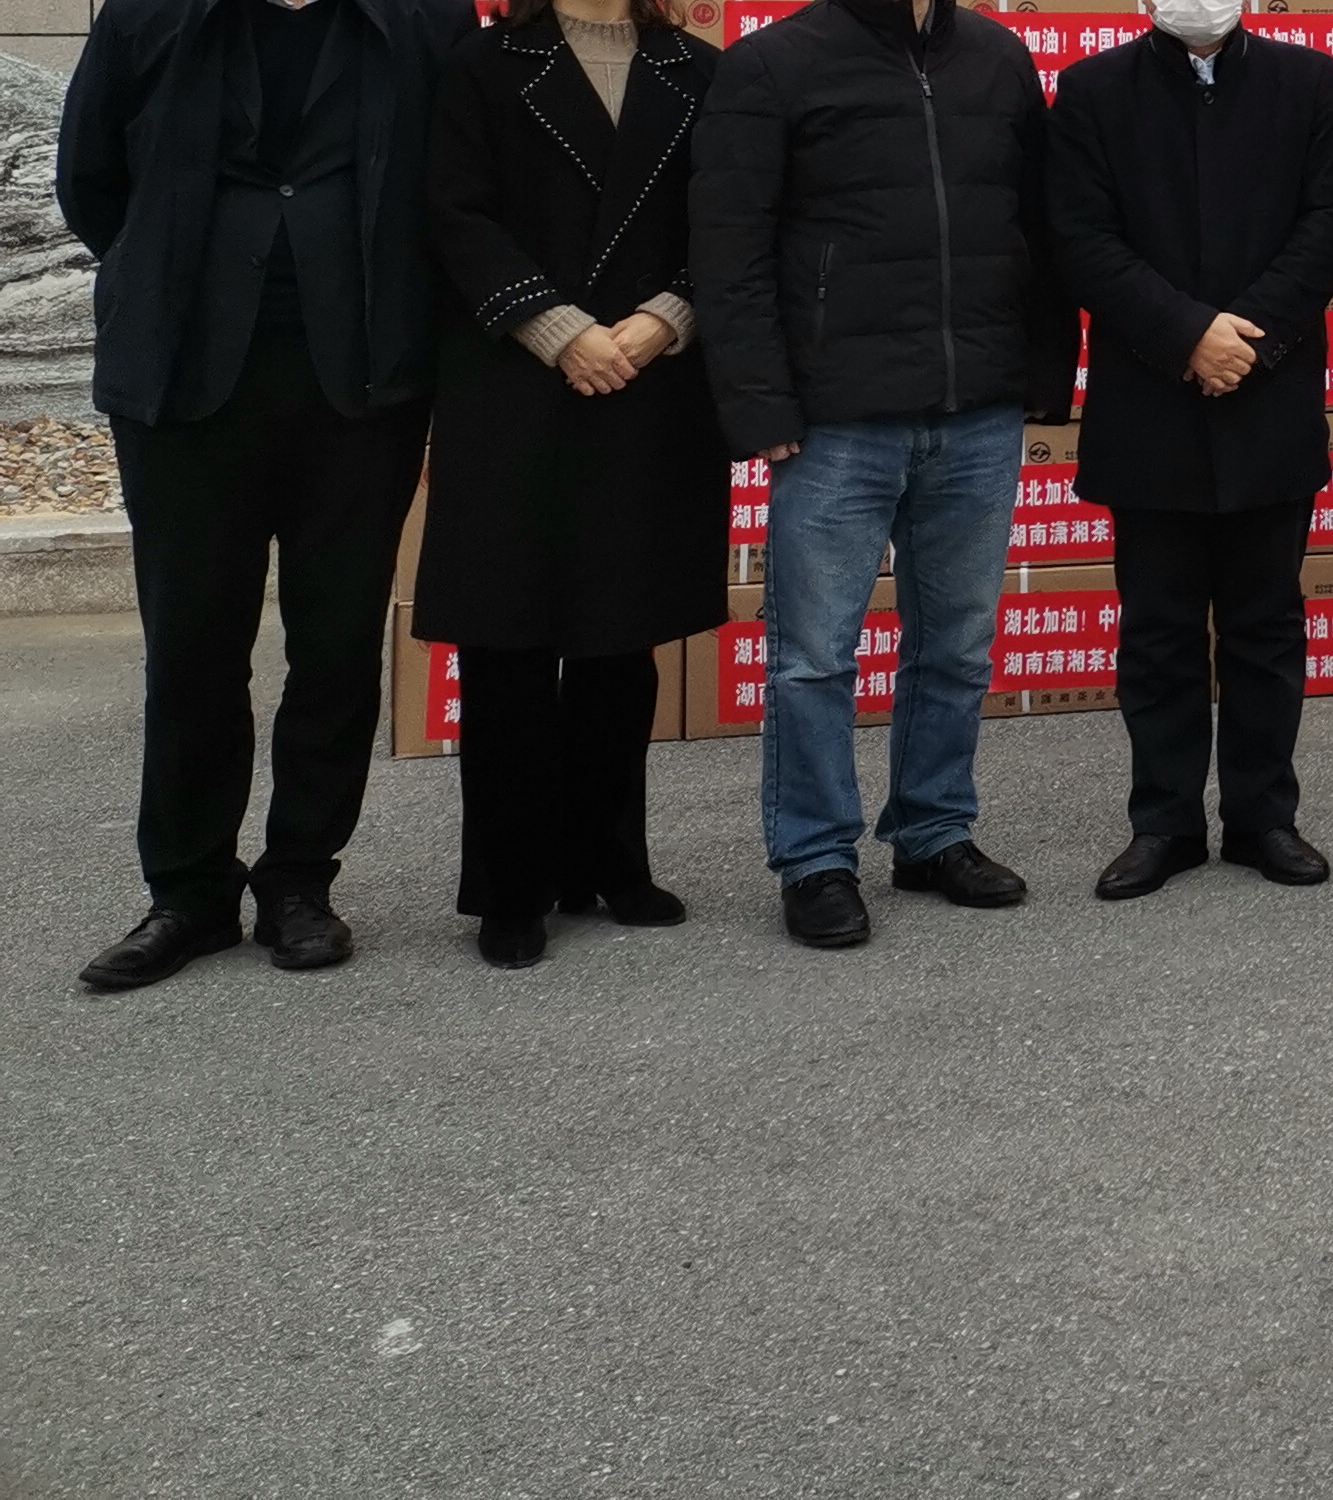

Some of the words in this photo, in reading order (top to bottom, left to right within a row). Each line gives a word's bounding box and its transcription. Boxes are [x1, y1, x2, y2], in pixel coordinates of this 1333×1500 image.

[1009, 518, 1116, 547] 湖南潇湘茶
[1004, 604, 1122, 636] 湖北加油！中
